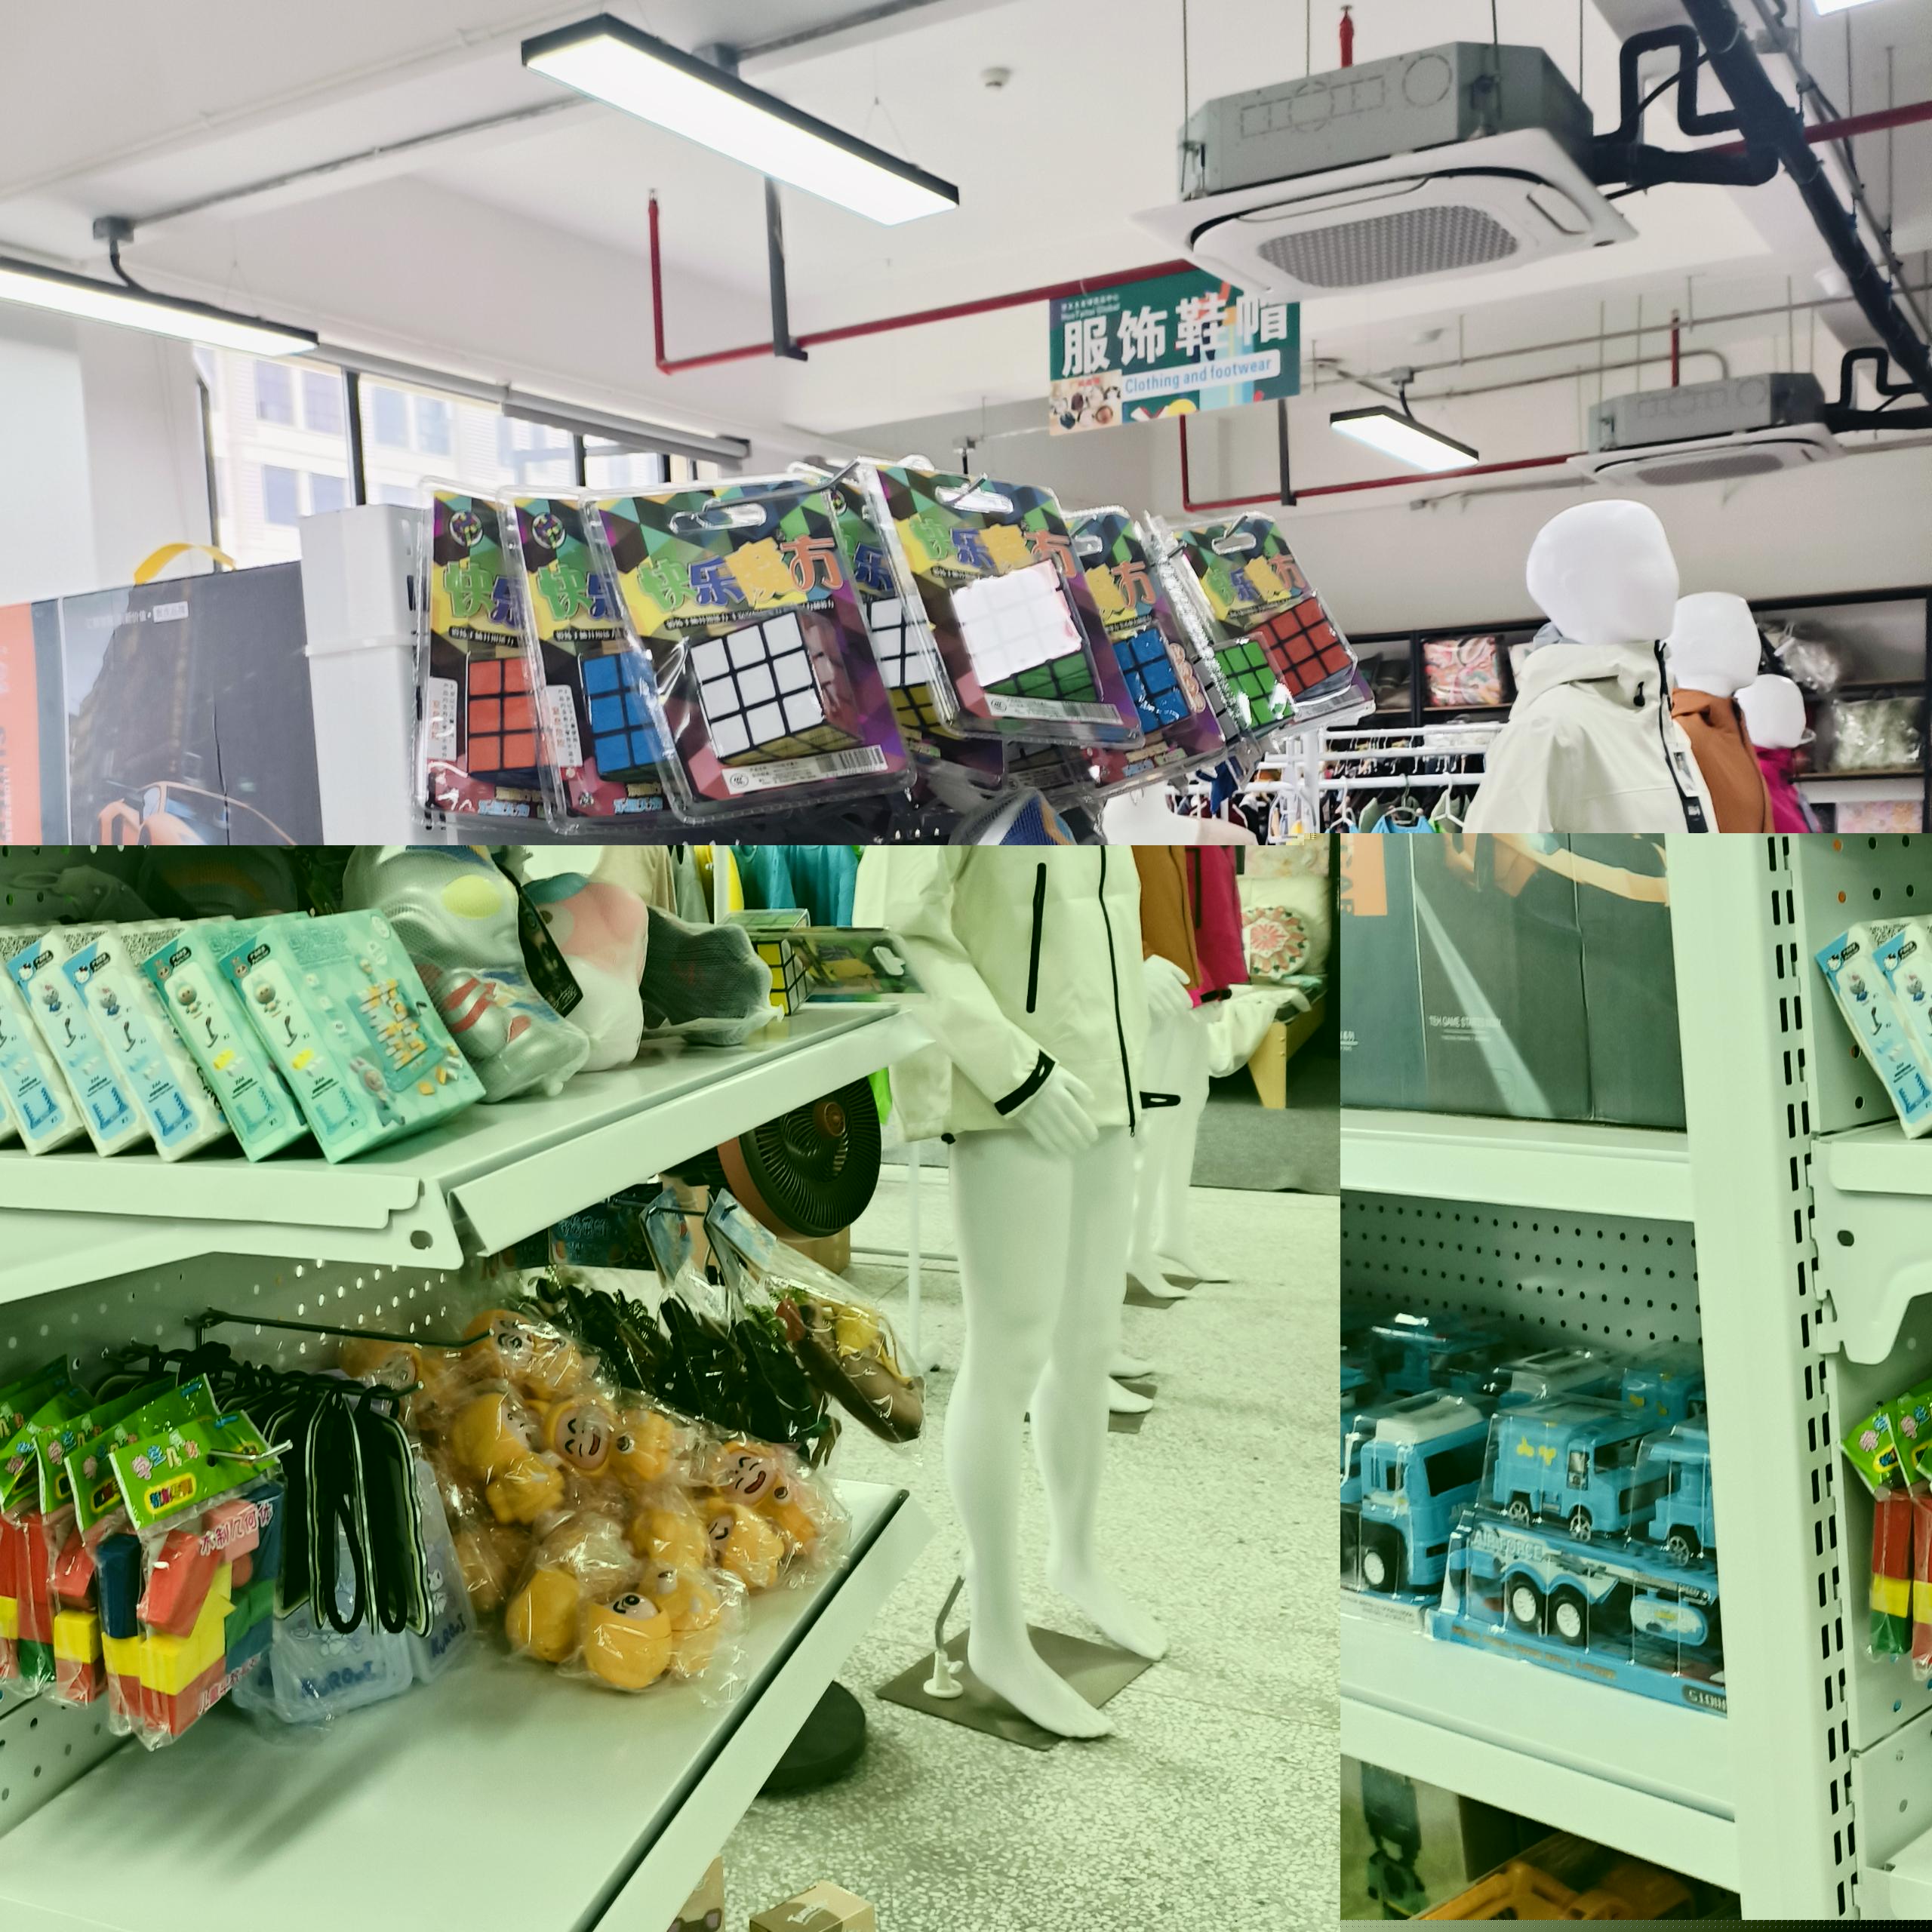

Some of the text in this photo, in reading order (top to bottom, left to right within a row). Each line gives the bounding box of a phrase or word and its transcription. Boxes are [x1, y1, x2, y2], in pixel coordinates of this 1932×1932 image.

[1062, 291, 1287, 378] 服饰鞋帽
[1124, 358, 1272, 394] Clothing and footwear
[1500, 1536, 1544, 1562] FORCE
